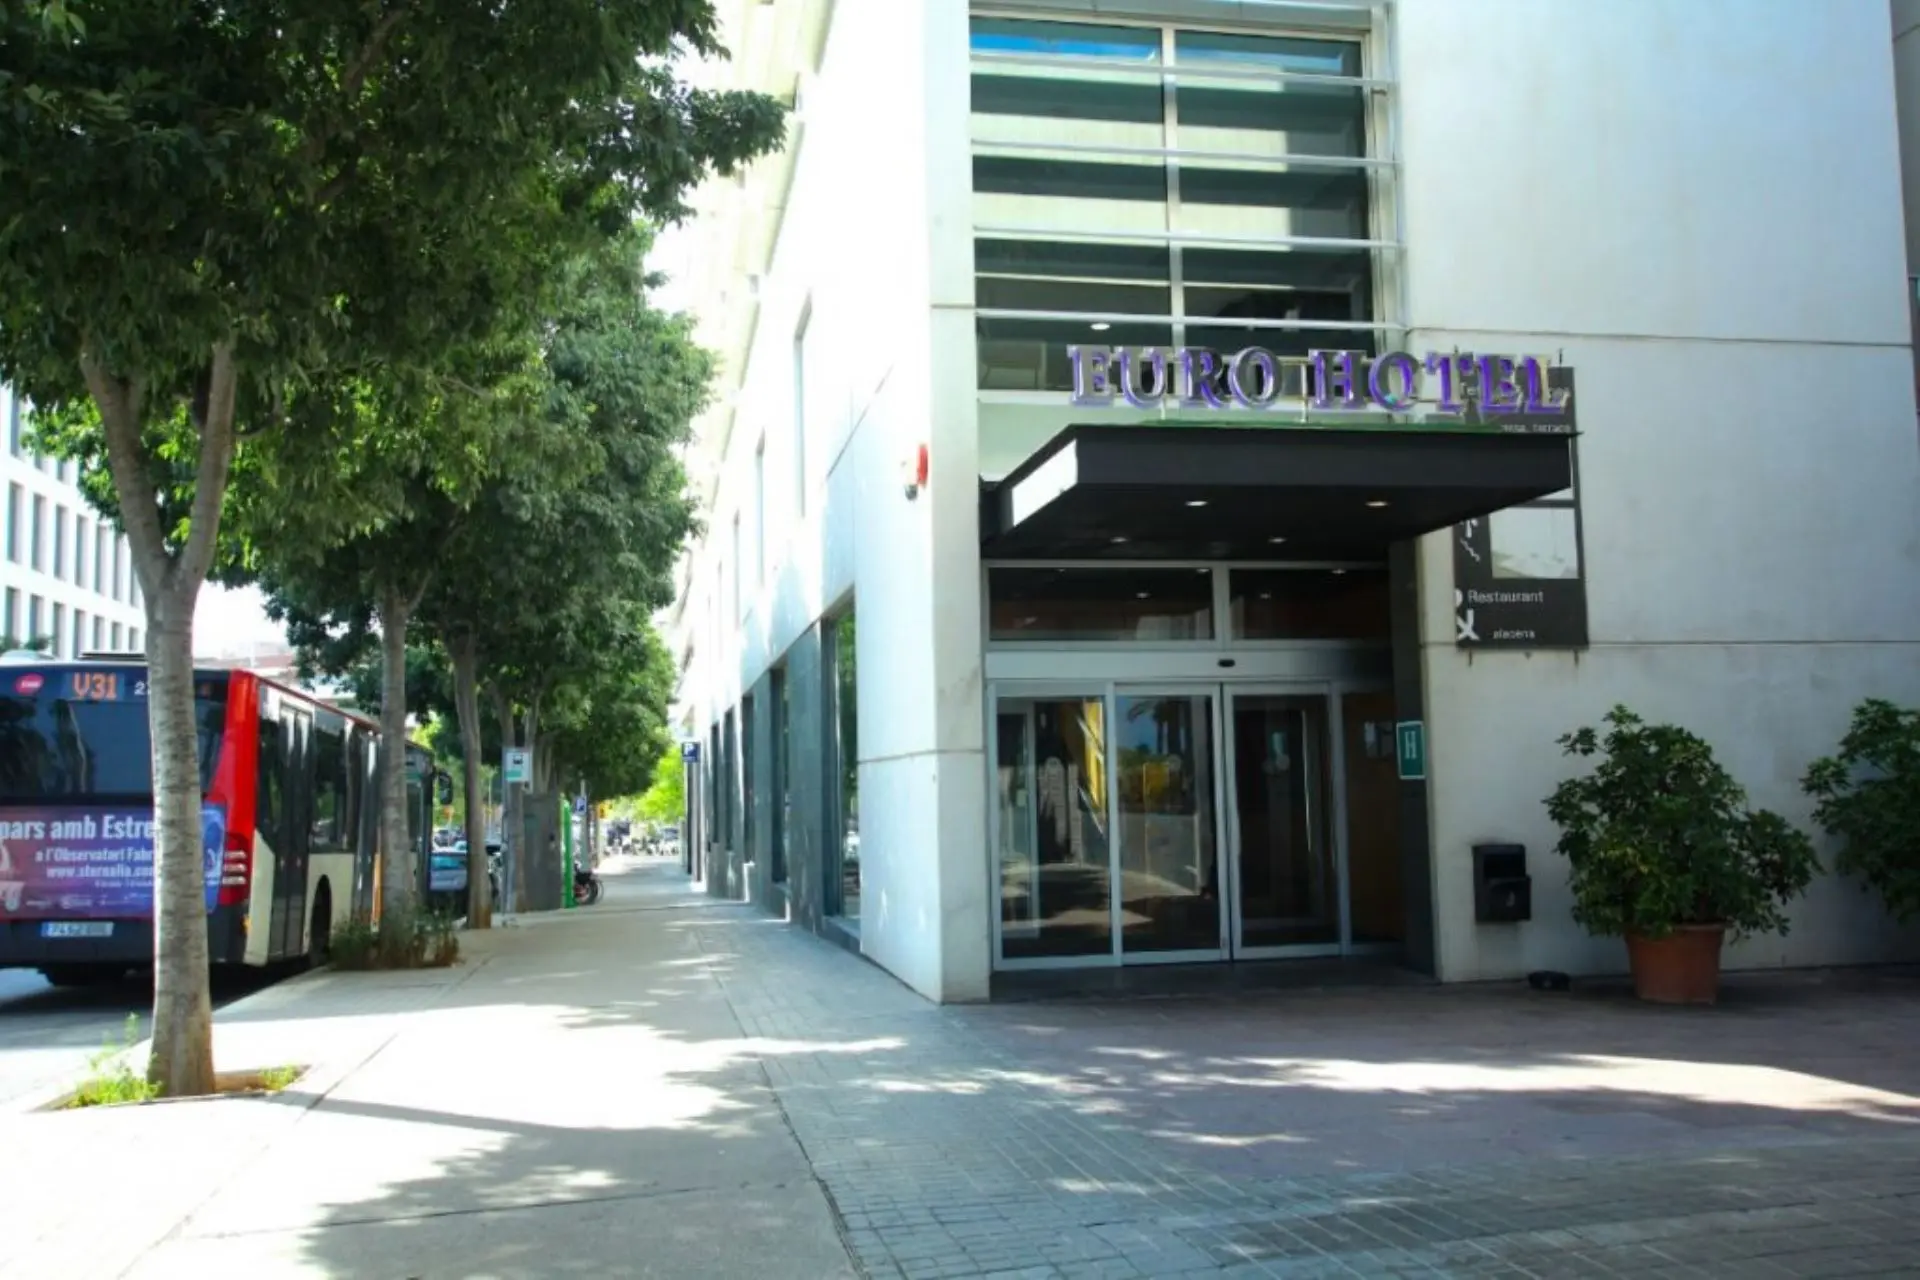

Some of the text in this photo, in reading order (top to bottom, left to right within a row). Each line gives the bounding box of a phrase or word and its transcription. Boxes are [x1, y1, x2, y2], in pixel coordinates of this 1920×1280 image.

[1067, 345, 1570, 415] EURO HOTEL
[1467, 589, 1544, 603] Restaurant
[73, 672, 117, 700] V31
[1405, 730, 1417, 760] H
[50, 815, 97, 840] amb
